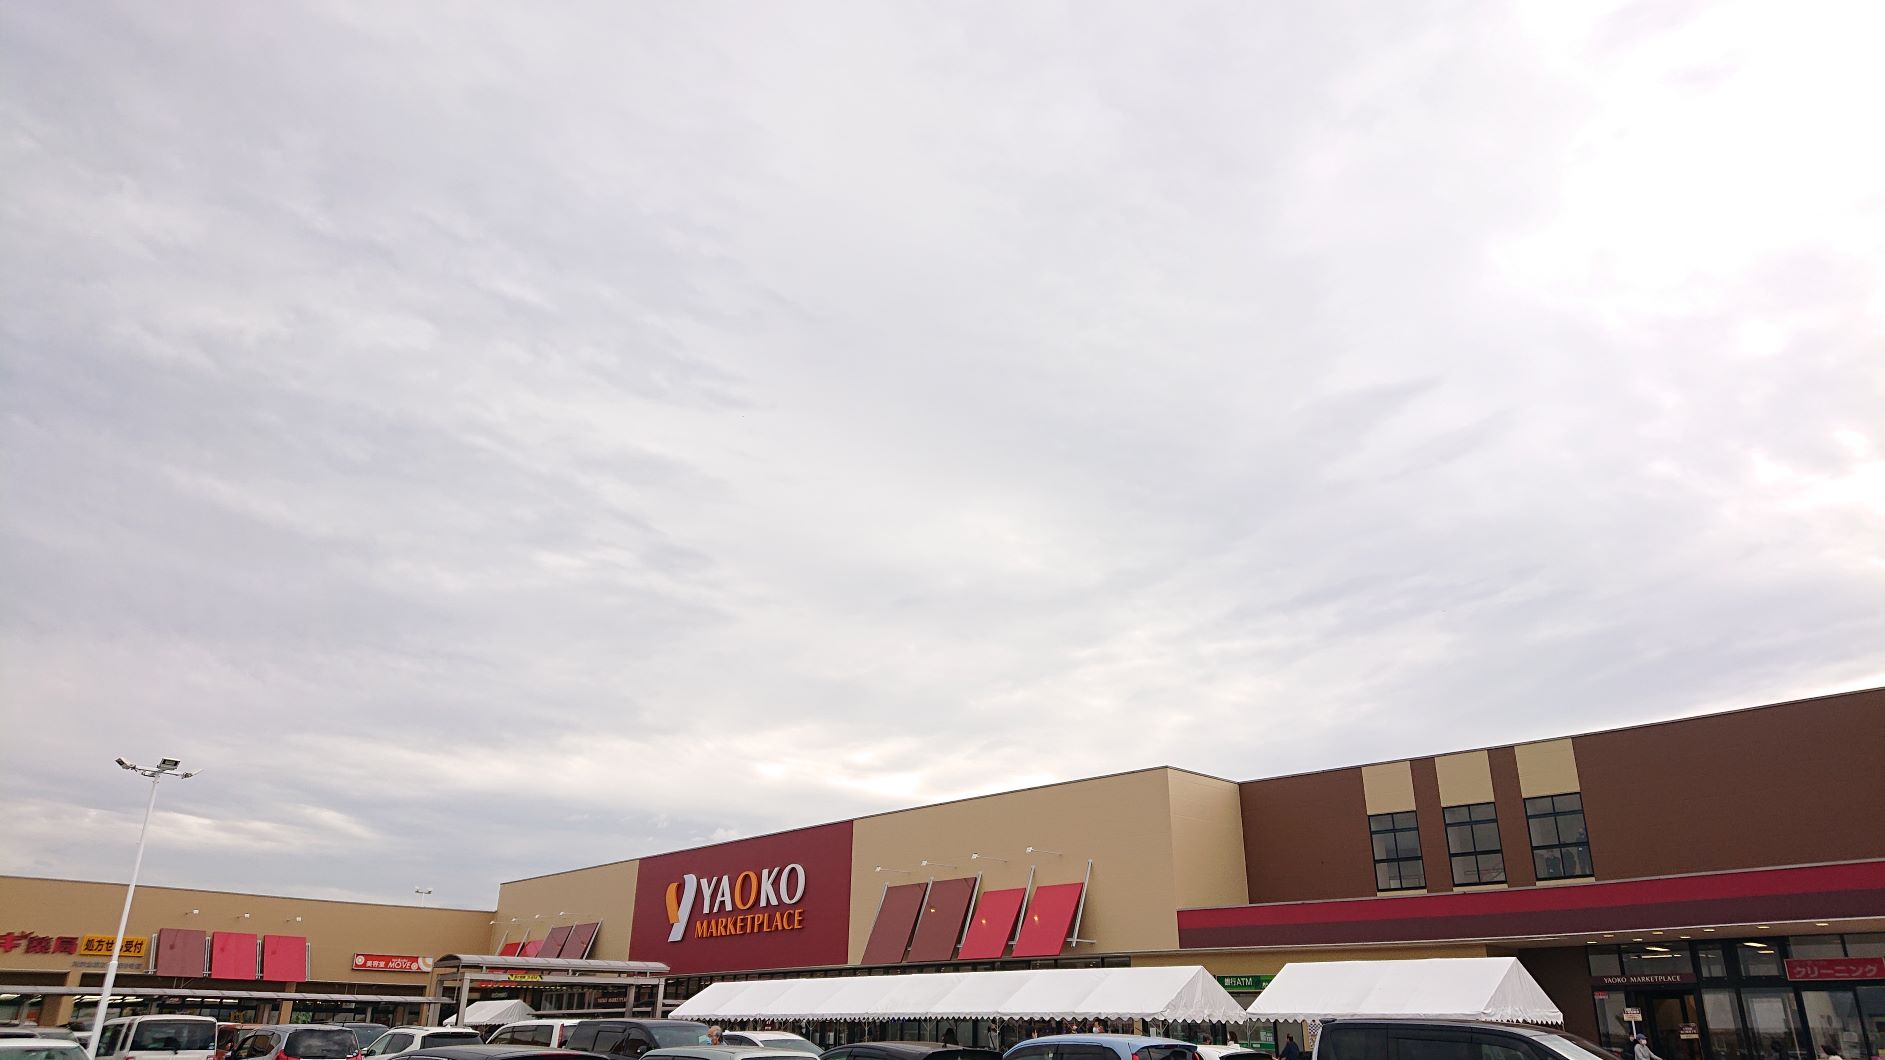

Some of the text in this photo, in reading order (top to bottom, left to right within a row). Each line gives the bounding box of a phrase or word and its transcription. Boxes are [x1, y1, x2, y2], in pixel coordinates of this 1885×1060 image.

[700, 863, 806, 914] YAOKO
[694, 908, 805, 939] MARKETPLACE
[387, 961, 412, 969] MOVE
[1793, 965, 1877, 977] クリーニング
[1630, 975, 1681, 983] MARKETPLACE
